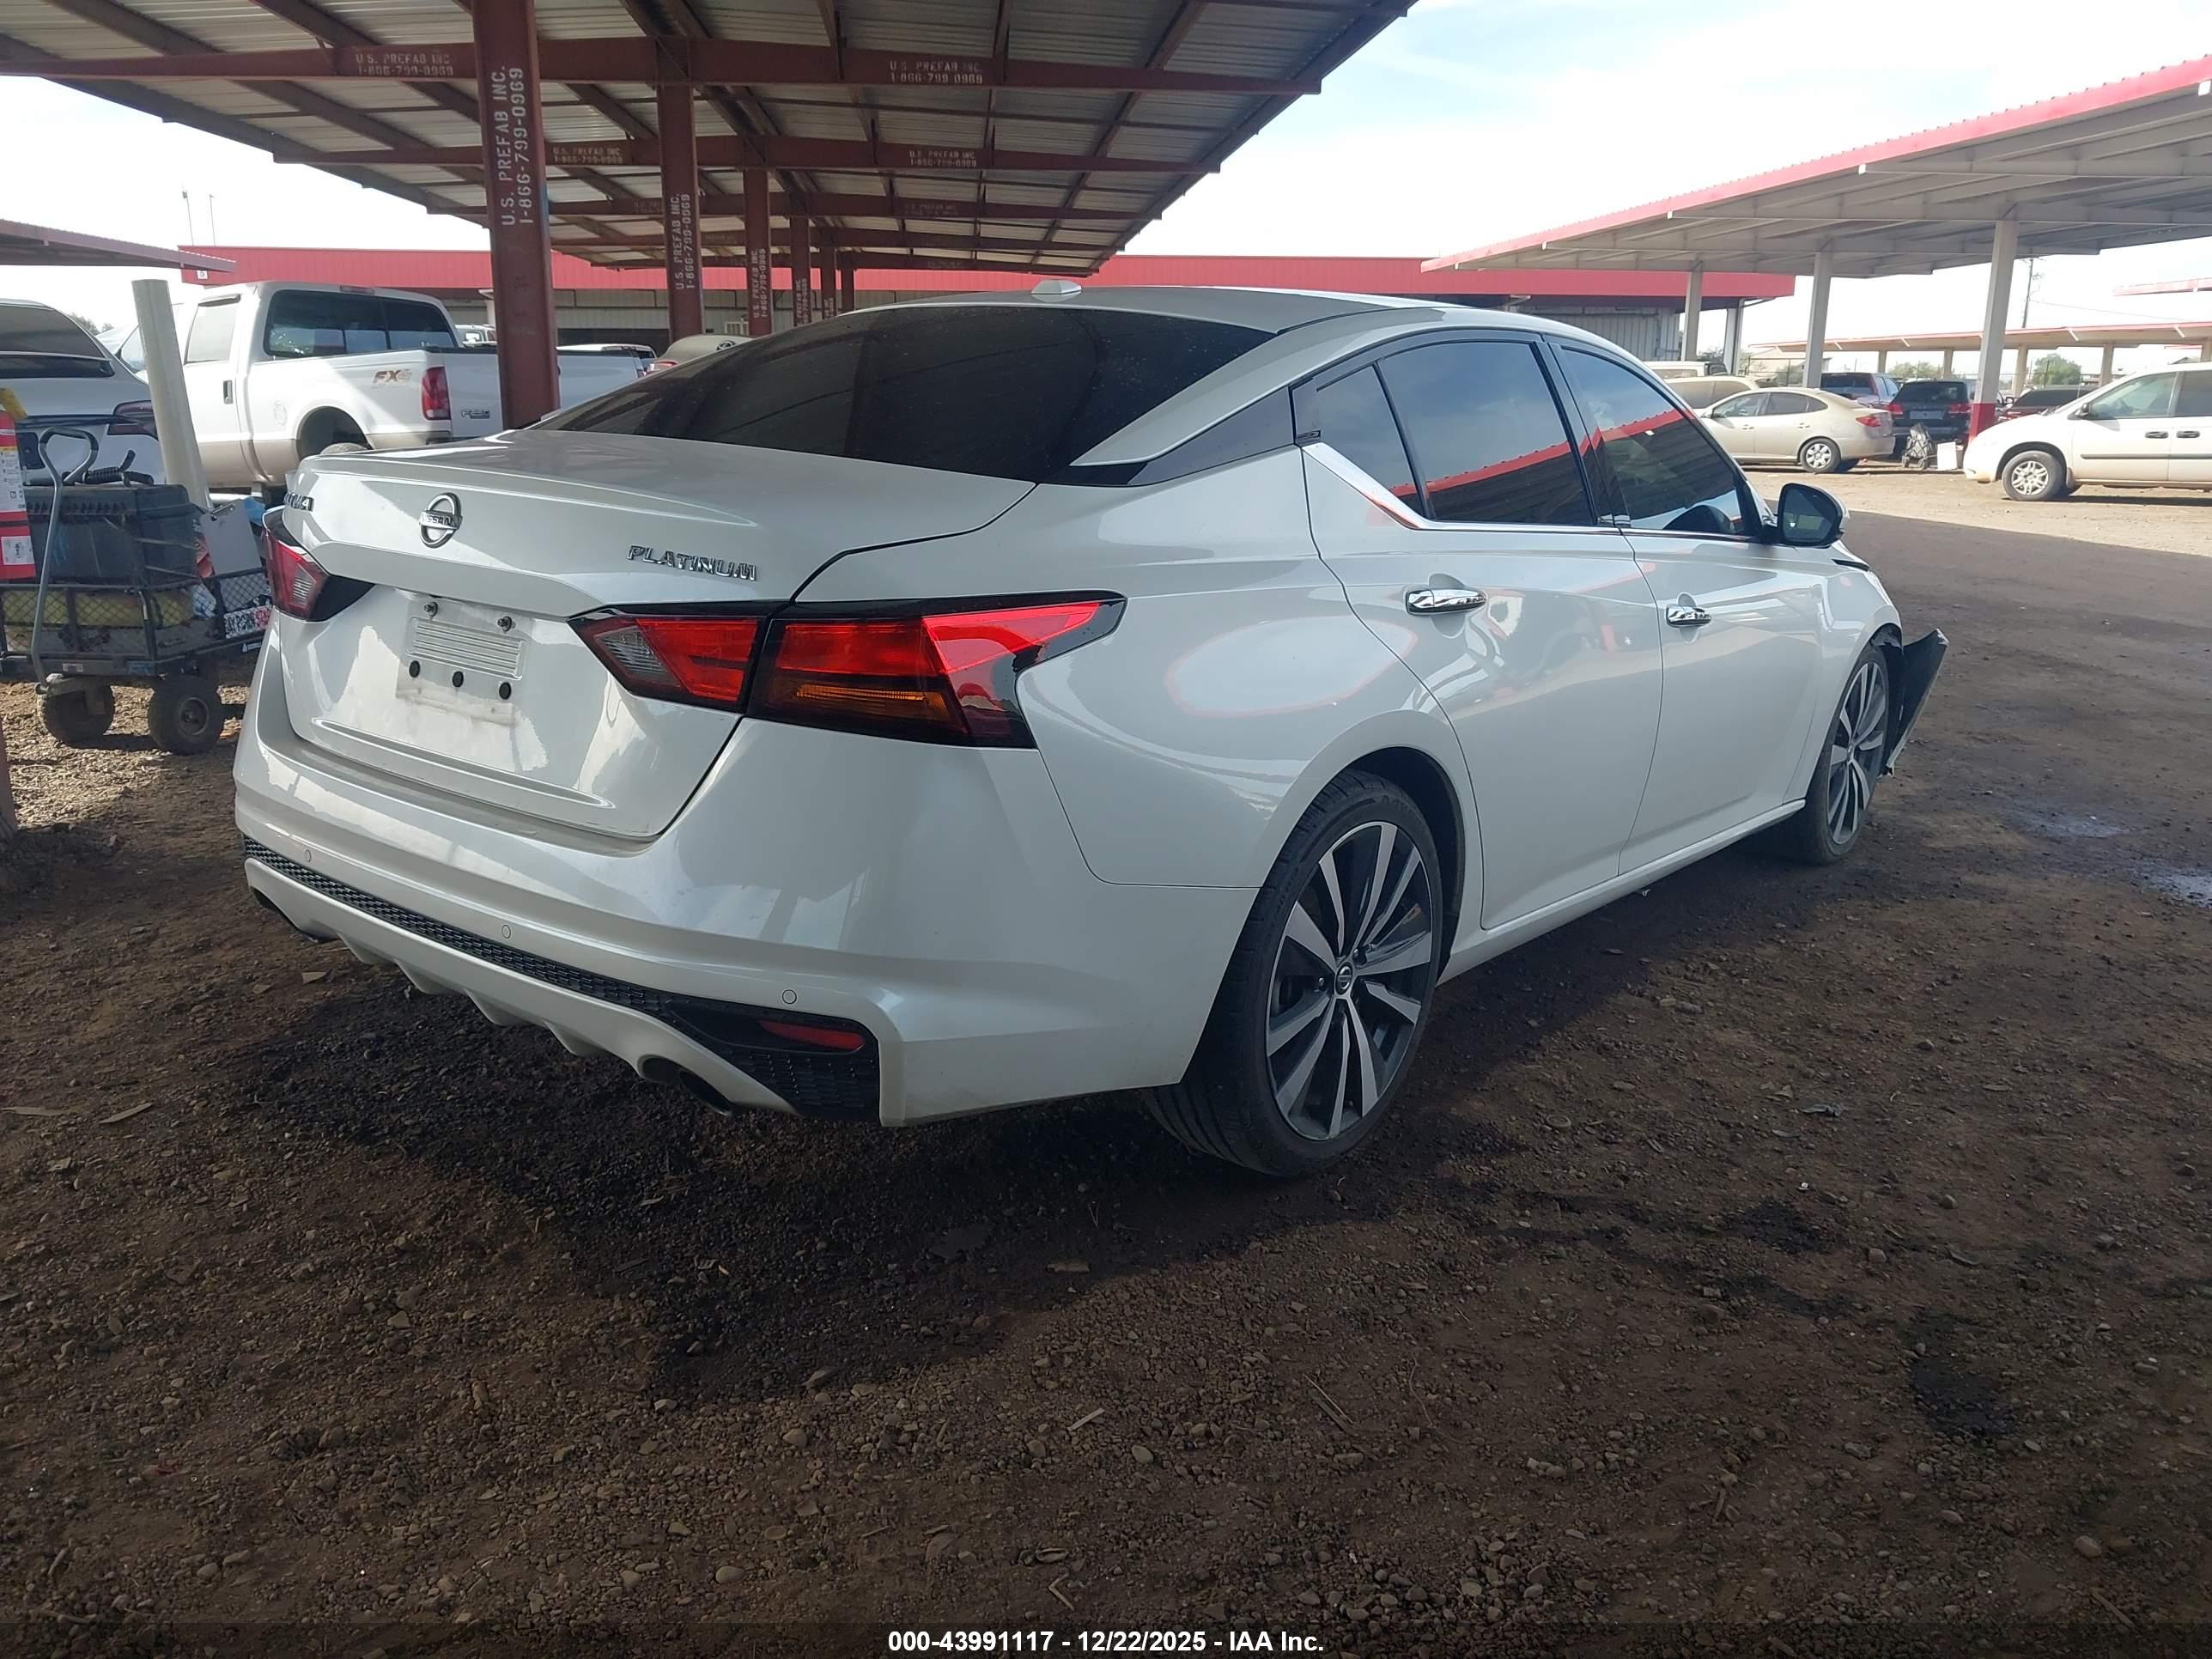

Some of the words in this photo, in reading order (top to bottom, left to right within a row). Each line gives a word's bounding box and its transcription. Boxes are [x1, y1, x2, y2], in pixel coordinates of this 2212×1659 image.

[491, 66, 508, 101] INC.
[495, 110, 513, 182] PREFAB
[508, 68, 534, 224] 1-866-799-0969
[501, 191, 516, 226] U.S.
[670, 193, 681, 215] INC.
[672, 220, 683, 264] PREFAB
[627, 545, 757, 581] PLATINUM
